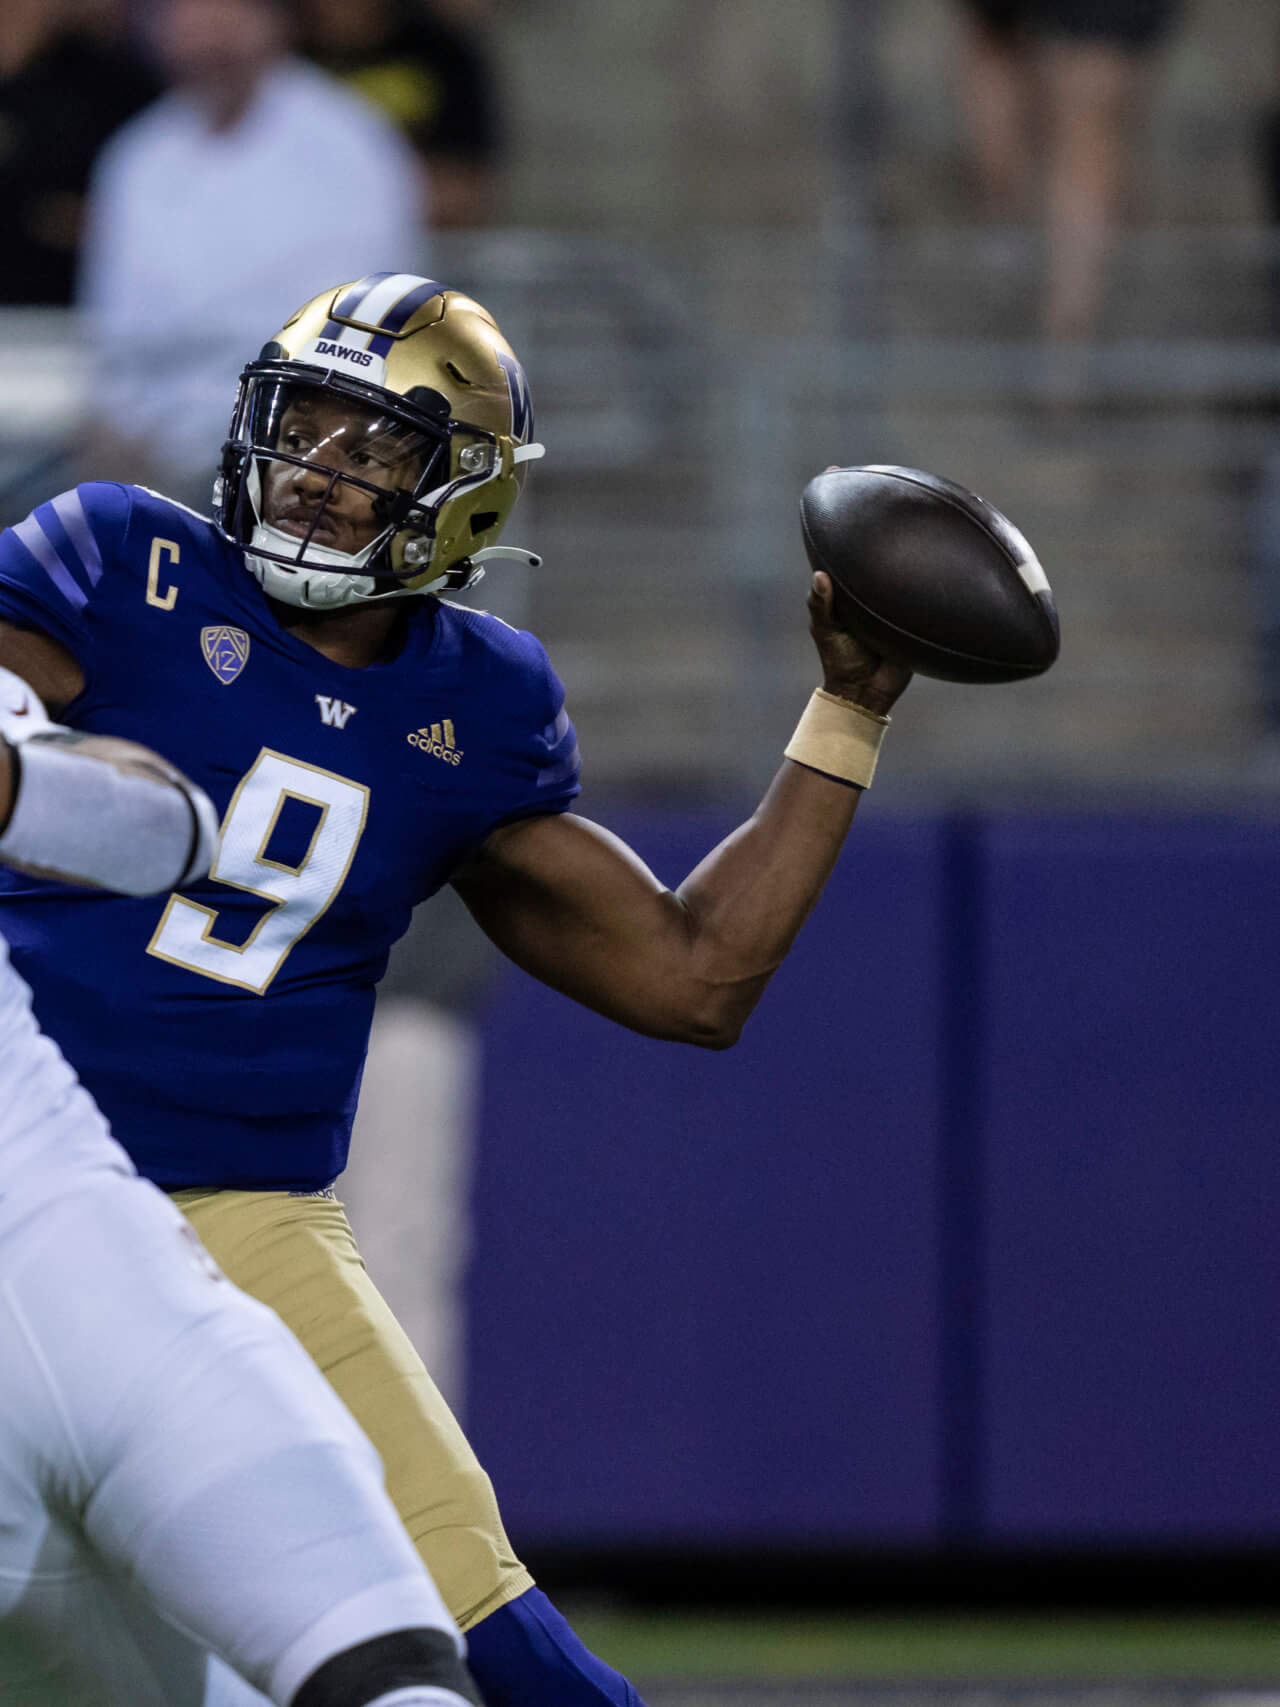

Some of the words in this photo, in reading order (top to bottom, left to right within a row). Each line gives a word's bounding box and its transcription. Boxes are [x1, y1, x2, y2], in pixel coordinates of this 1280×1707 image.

[314, 341, 373, 367] DAWGS
[146, 536, 180, 611] C
[315, 693, 358, 730] W
[407, 732, 460, 766] adidas
[146, 746, 370, 997] 9
